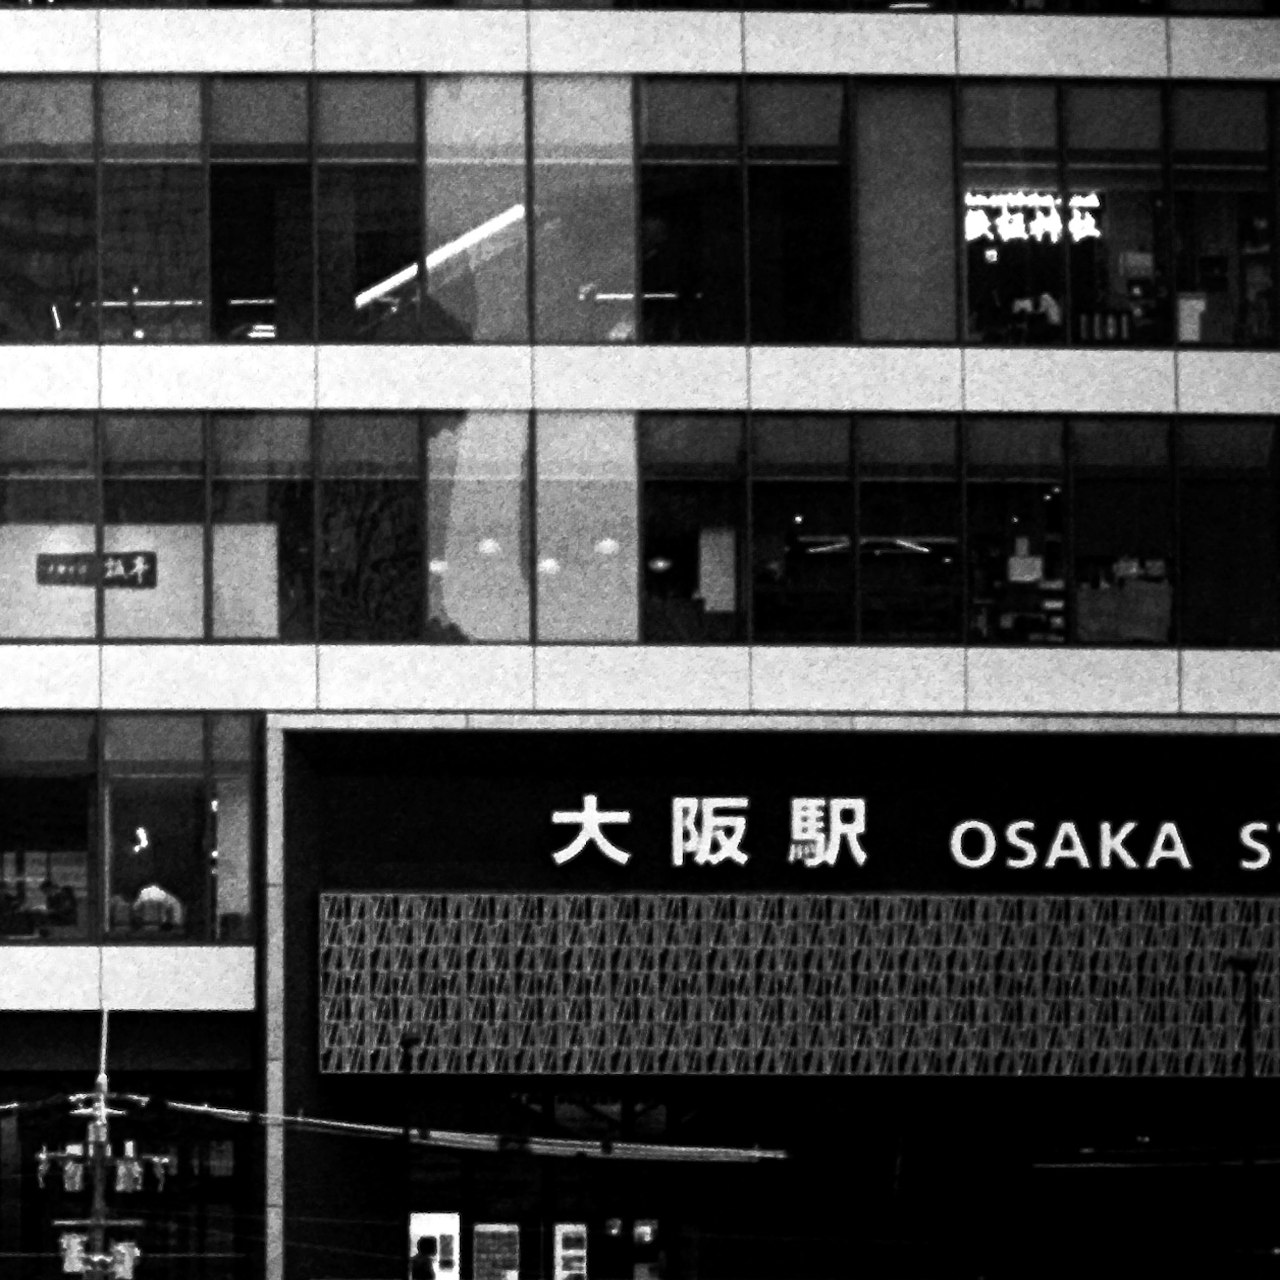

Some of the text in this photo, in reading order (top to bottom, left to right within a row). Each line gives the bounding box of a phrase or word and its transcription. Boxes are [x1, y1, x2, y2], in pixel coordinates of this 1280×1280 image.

[551, 794, 868, 868] 大阪駅
[950, 820, 1280, 870] OSAKA S
